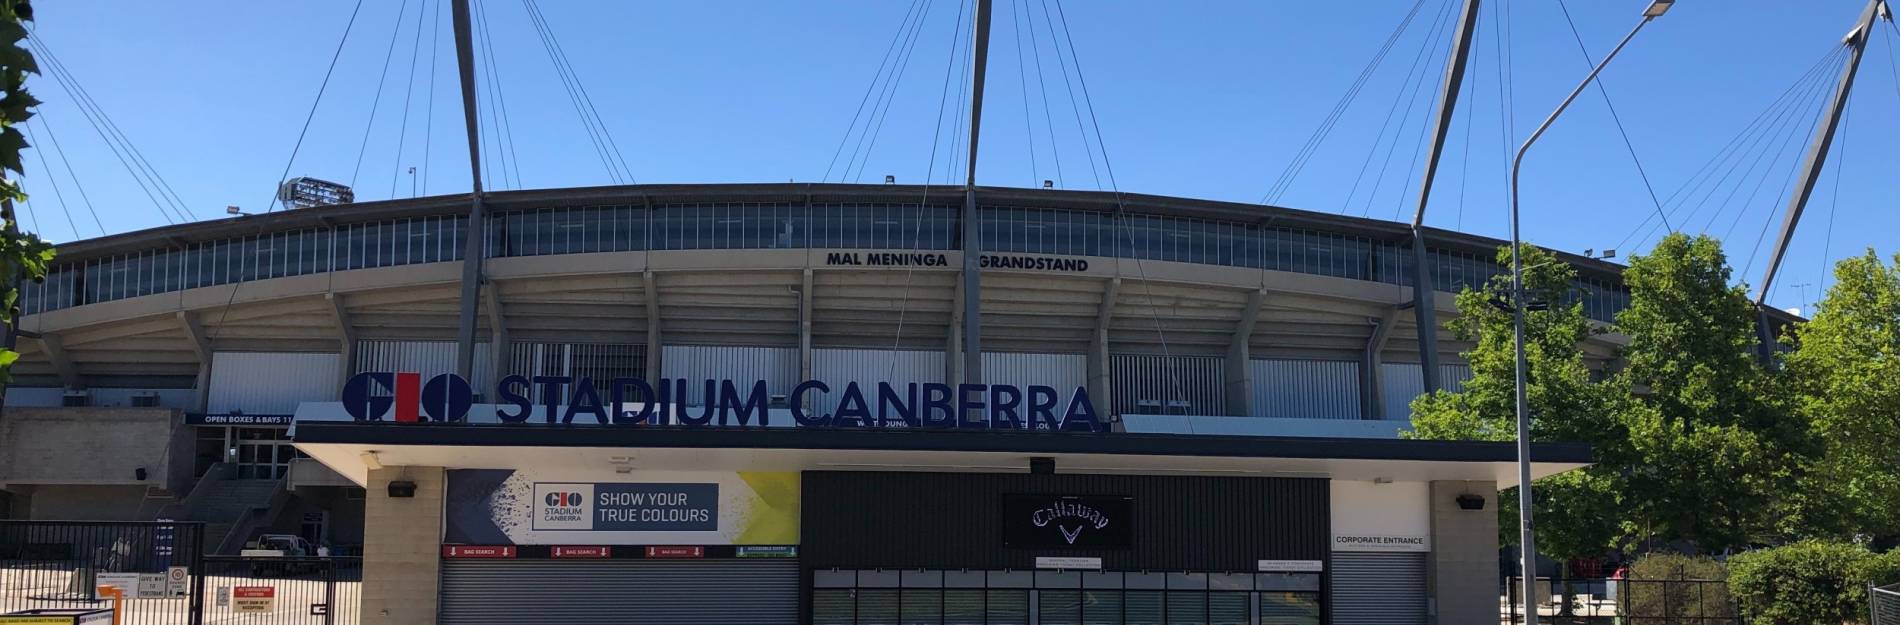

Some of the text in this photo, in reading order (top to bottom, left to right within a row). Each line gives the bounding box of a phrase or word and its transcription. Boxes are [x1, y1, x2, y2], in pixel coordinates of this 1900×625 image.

[826, 252, 1089, 272] MAL MENINGA GRANDSTAND
[342, 371, 1101, 432] GIO STADIUM CANBERRA
[545, 491, 583, 507] GIO
[600, 492, 688, 506] SHOW YOUR
[544, 507, 582, 515] STADIUM
[600, 508, 709, 522] TRUE COLOURS
[1032, 500, 1109, 529] Callaway
[1336, 536, 1424, 545] CORPORATE ENTRANCE
